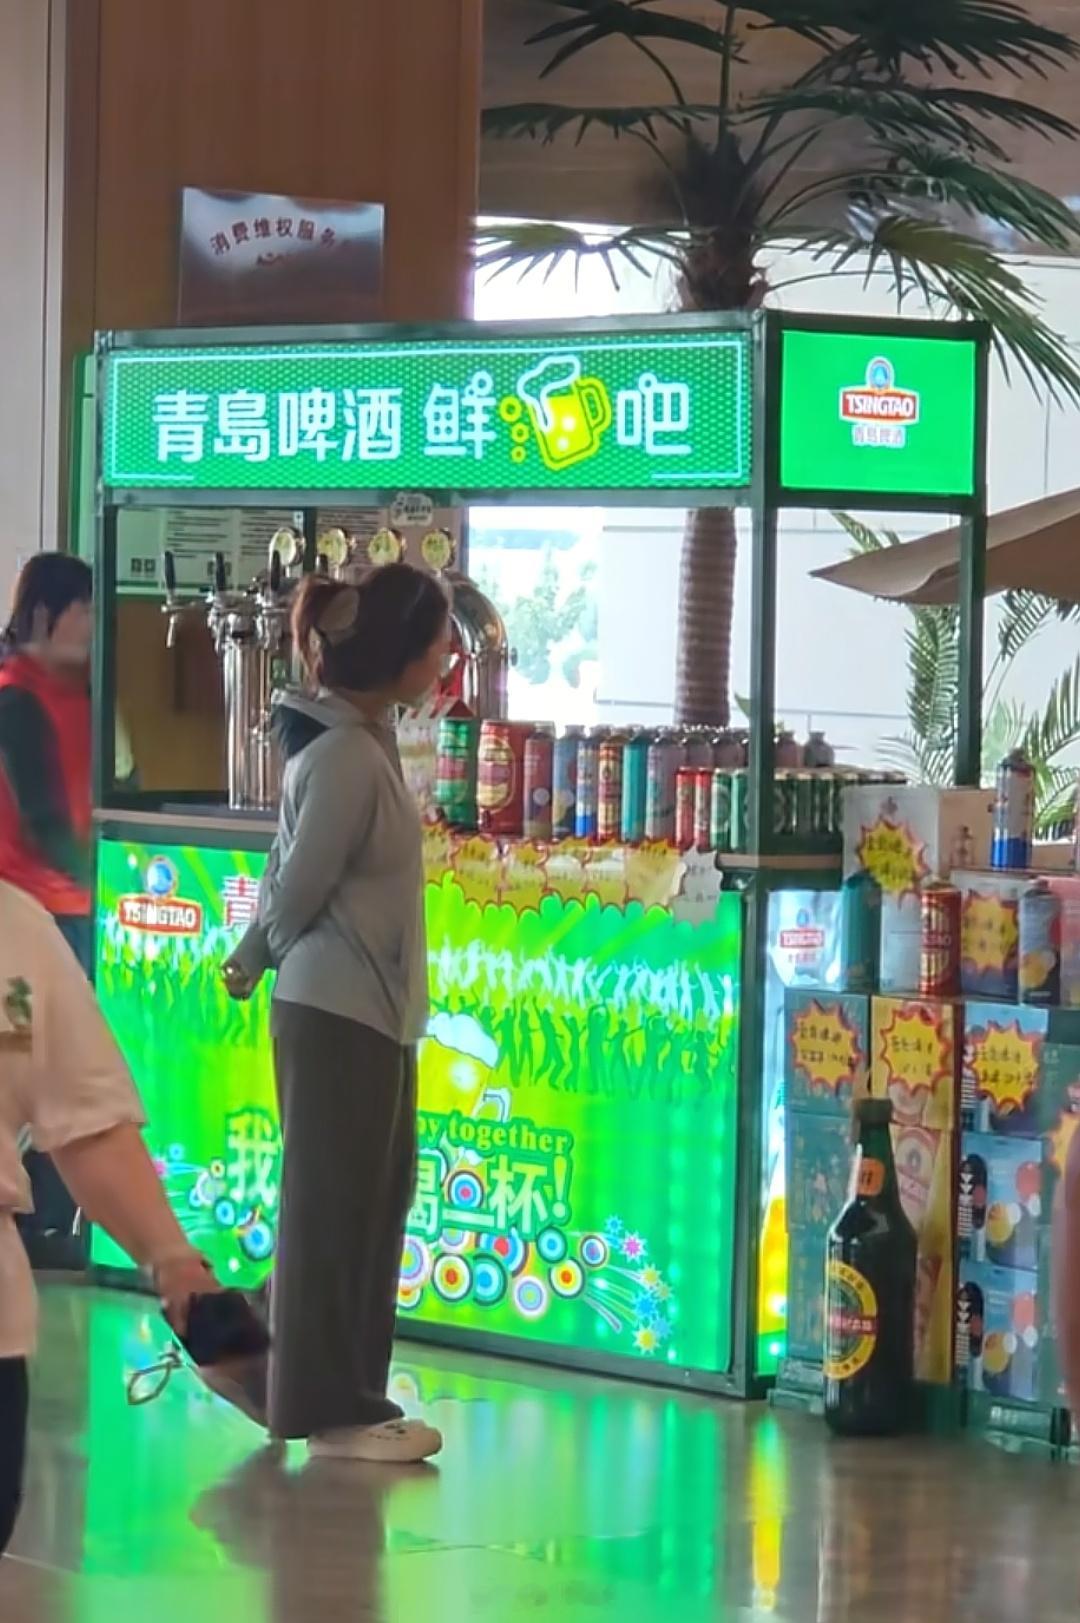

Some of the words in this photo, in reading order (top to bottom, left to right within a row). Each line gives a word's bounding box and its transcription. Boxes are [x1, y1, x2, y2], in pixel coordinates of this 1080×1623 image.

[617, 373, 692, 455] 吧
[846, 394, 915, 417] TSINGTAO
[123, 900, 197, 929] TSINGTAO
[449, 1117, 568, 1154] together
